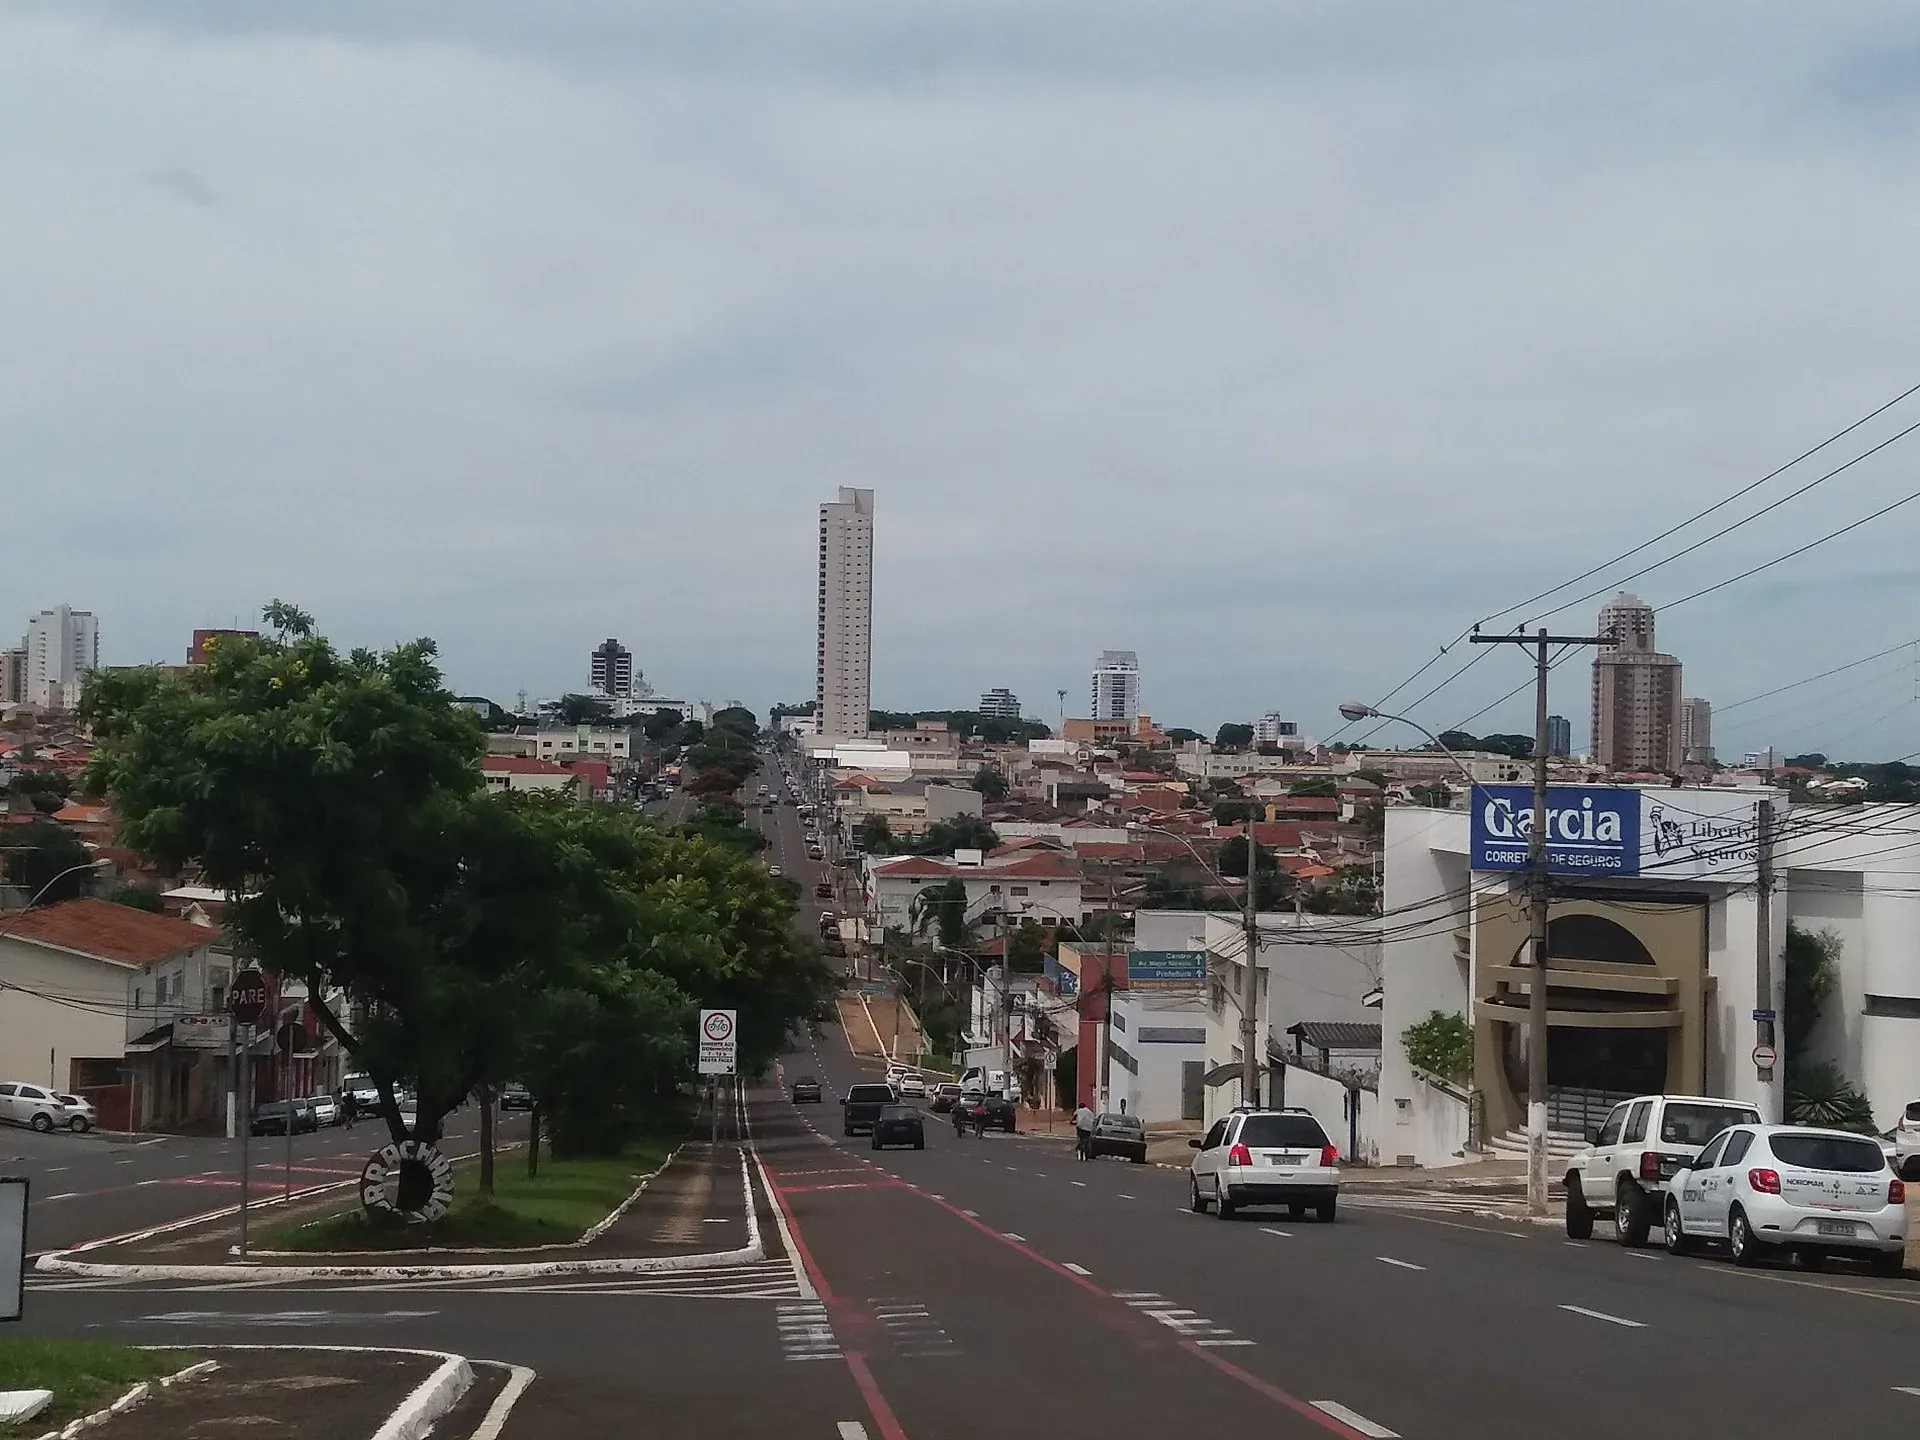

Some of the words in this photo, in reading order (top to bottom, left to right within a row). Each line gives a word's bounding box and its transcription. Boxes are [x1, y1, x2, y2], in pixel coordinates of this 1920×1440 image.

[1484, 797, 1623, 842] Garcia
[1691, 821, 1749, 839] Liberty
[1485, 850, 1547, 865] CORRET
[1551, 853, 1566, 865] DE
[1567, 854, 1622, 868] SEGUROS
[1690, 844, 1758, 866] Seguros
[1155, 970, 1192, 978] Prefeitura
[232, 987, 265, 1005] PARE
